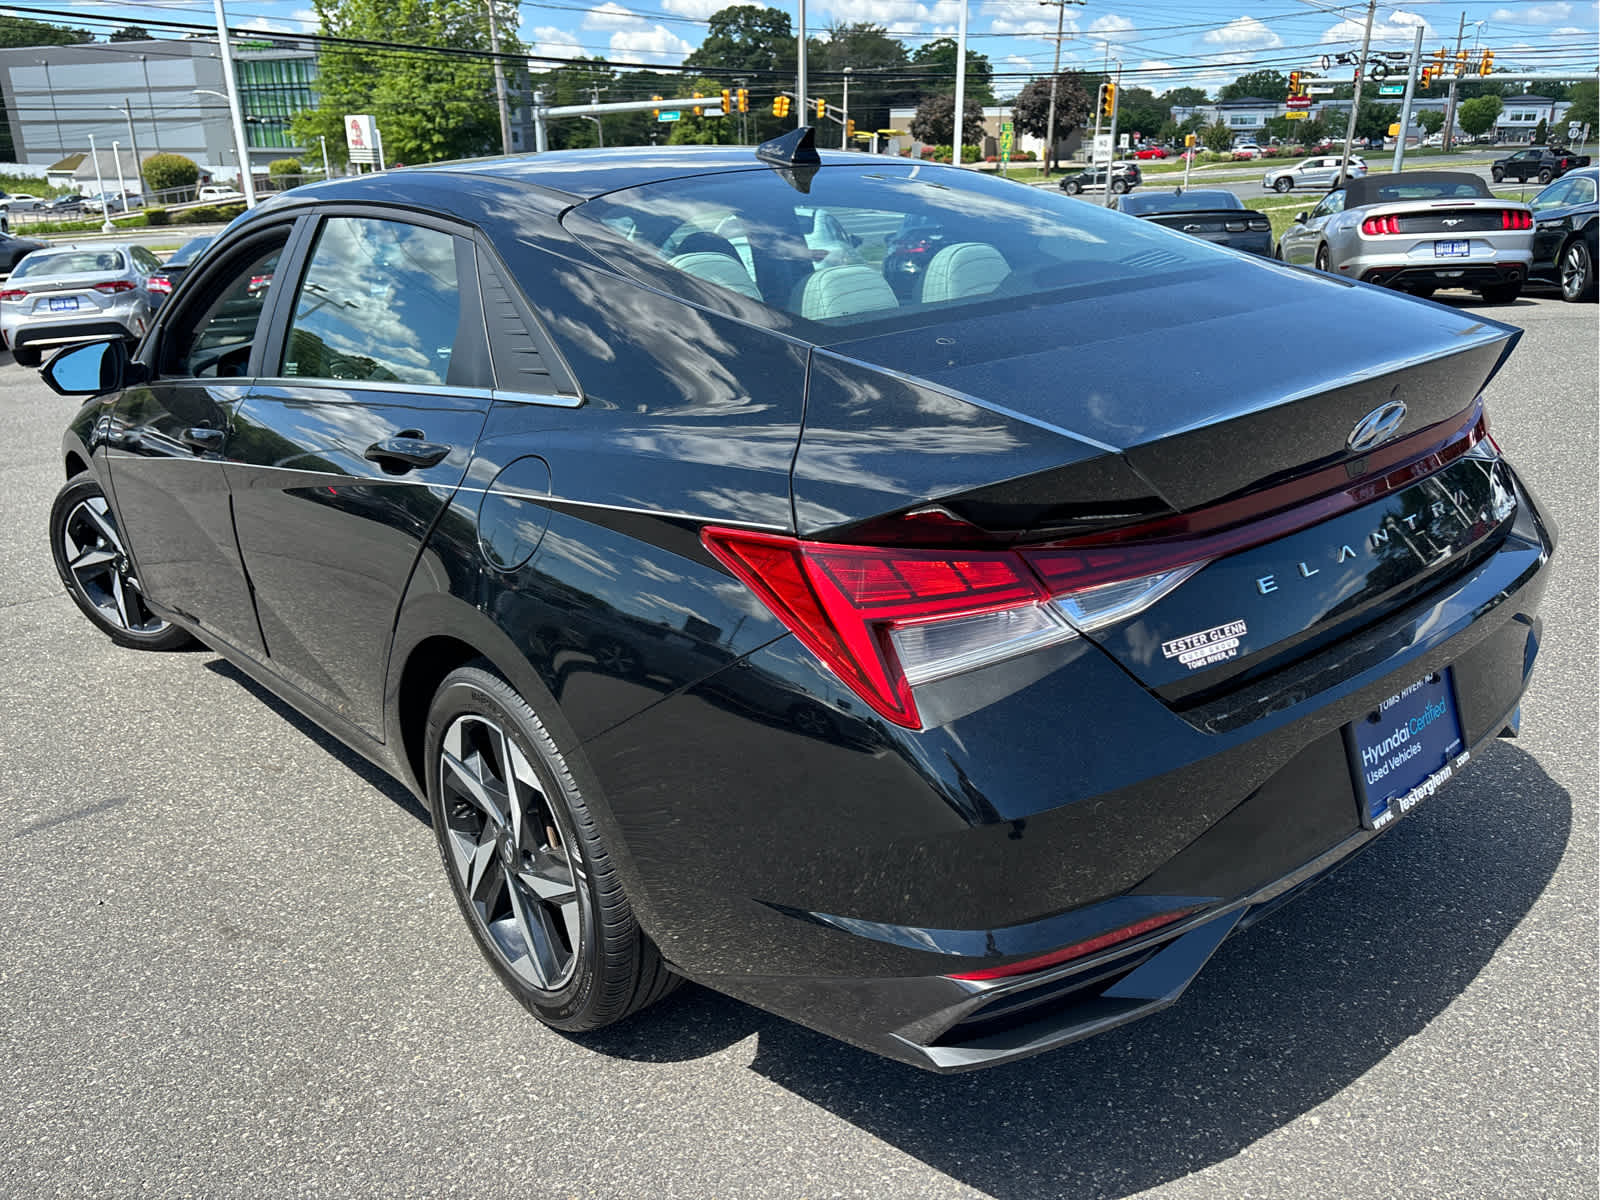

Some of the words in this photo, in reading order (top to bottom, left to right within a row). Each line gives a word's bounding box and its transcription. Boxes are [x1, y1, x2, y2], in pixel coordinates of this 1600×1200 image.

[1256, 488, 1470, 595] ELANTRA
[1162, 634, 1208, 656] LESTER
[1209, 621, 1247, 641] GLENN
[1186, 658, 1208, 670] TOMS
[1228, 648, 1237, 657] NJ
[1378, 693, 1401, 713] TOMS
[1361, 722, 1411, 767] Hyundai
[1409, 695, 1447, 735] Certified
[1366, 763, 1389, 785] Used
[1389, 741, 1422, 770] Vehicles
